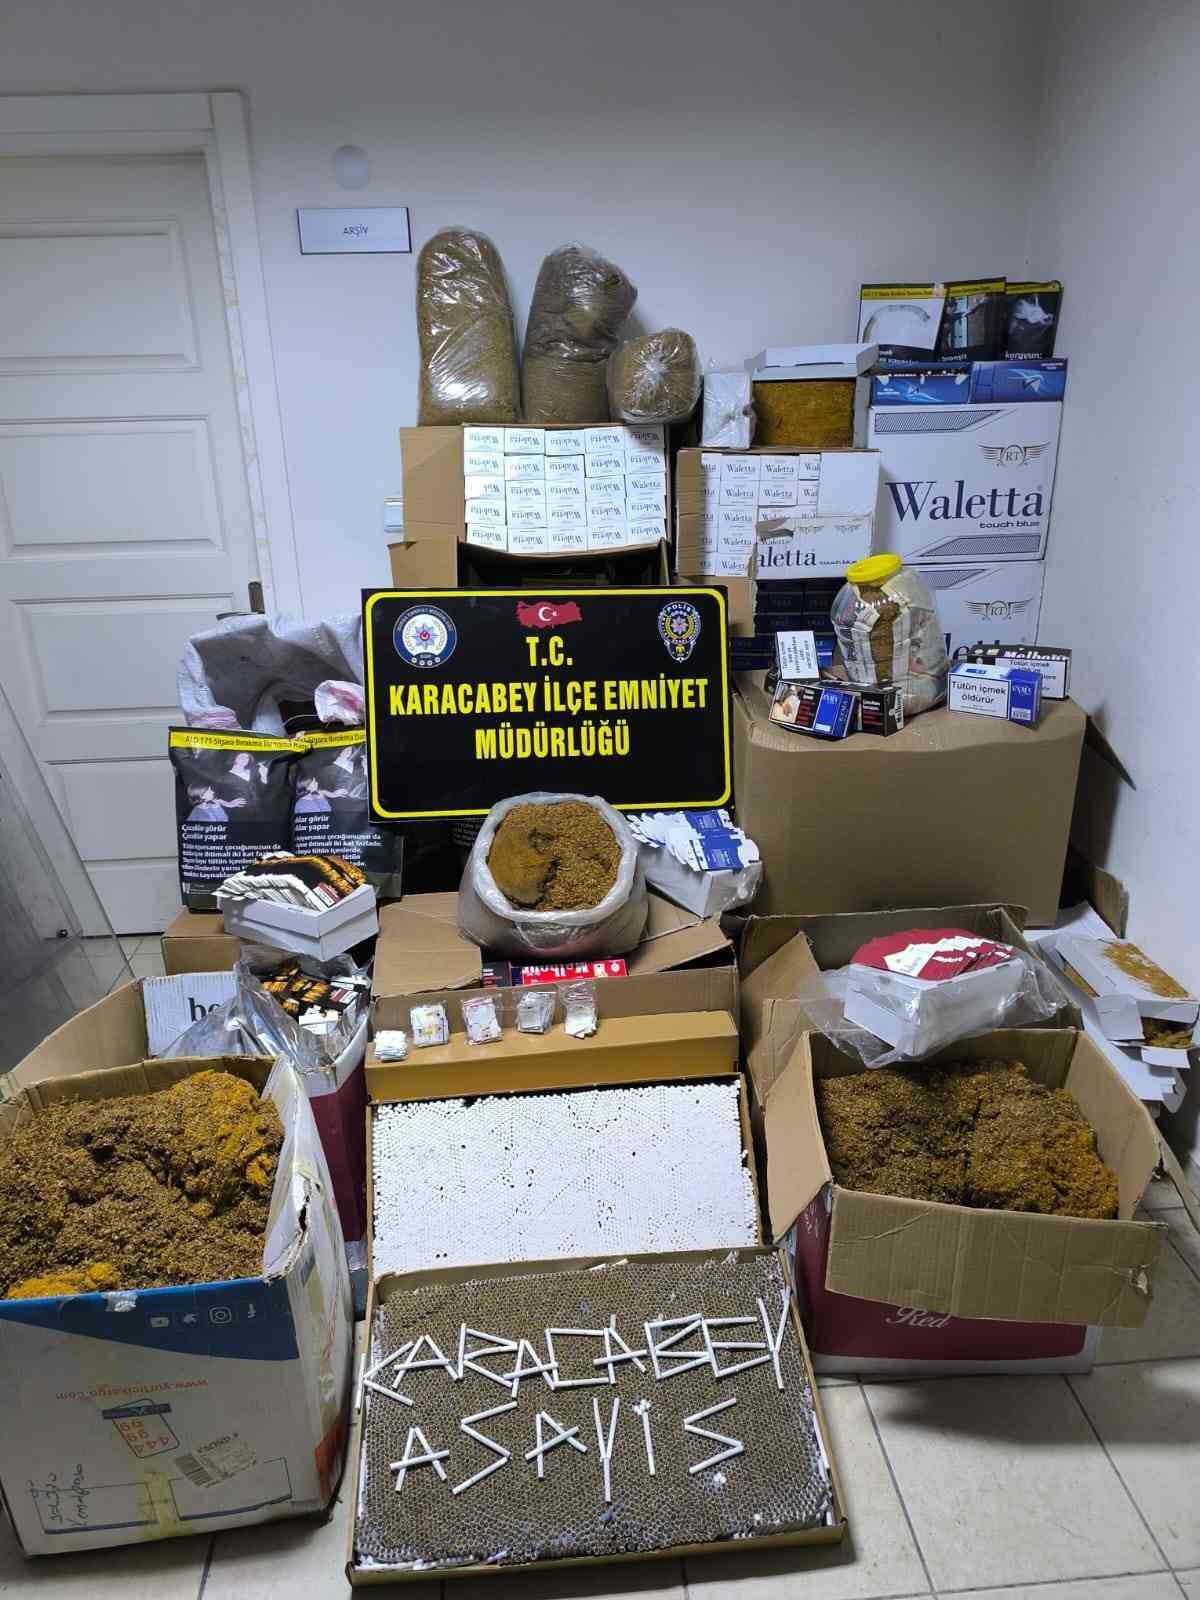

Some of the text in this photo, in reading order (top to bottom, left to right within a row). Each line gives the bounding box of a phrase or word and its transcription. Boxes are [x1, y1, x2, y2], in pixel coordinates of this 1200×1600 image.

[1006, 451, 1020, 462] RT
[766, 463, 795, 473] Waletta
[764, 488, 793, 498] Waletta
[885, 480, 1044, 522] Waletta
[979, 520, 1040, 529] touch blue
[759, 546, 817, 568] aletta
[525, 635, 574, 667] T.C.
[389, 673, 709, 716] KARACABEY İLÇE EMNİYET
[951, 680, 978, 692] Tütün
[979, 686, 1007, 696] içmek
[961, 693, 995, 704] öldürür
[475, 719, 630, 760] MÜDÜRLÜĞÜ
[308, 816, 329, 824] görür
[308, 824, 330, 832] yapar
[885, 1305, 952, 1329] Red
[355, 1286, 791, 1410] KARACABEY
